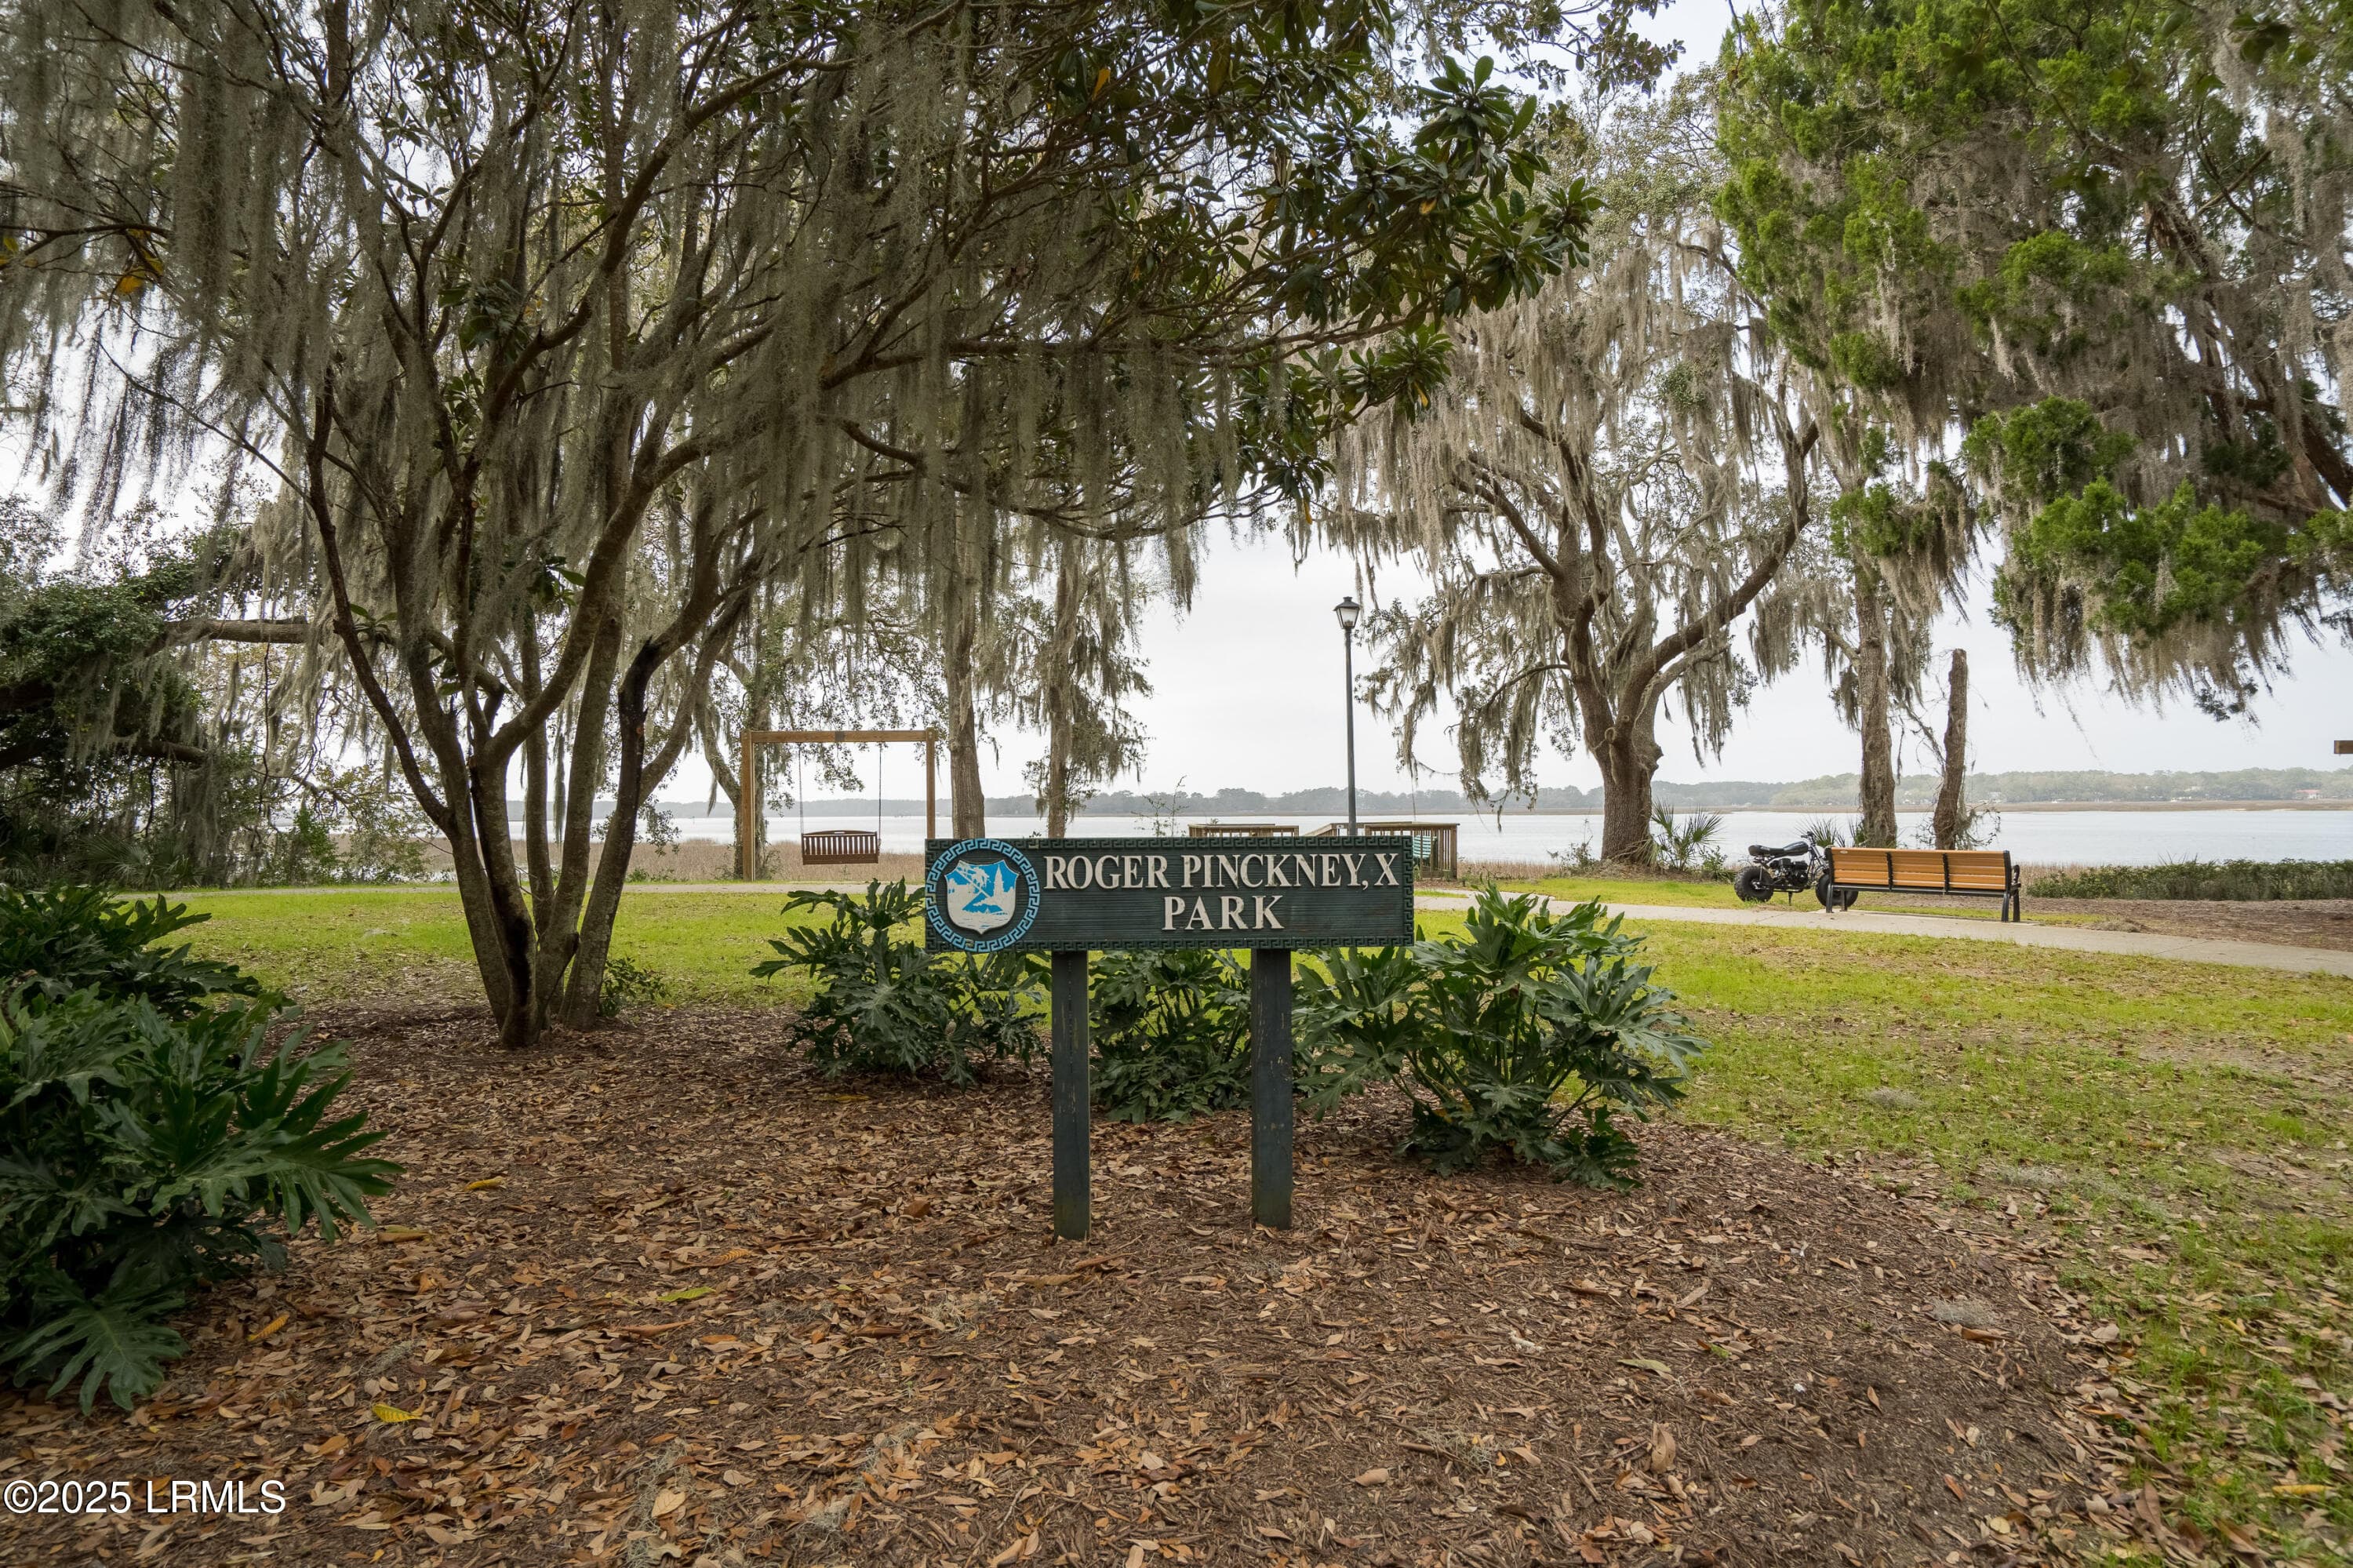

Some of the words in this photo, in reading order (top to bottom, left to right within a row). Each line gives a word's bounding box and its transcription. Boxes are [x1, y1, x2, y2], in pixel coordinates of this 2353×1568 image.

[1043, 854, 1172, 890] ROGER
[1373, 853, 1401, 886] X
[1161, 895, 1286, 931] PARK
